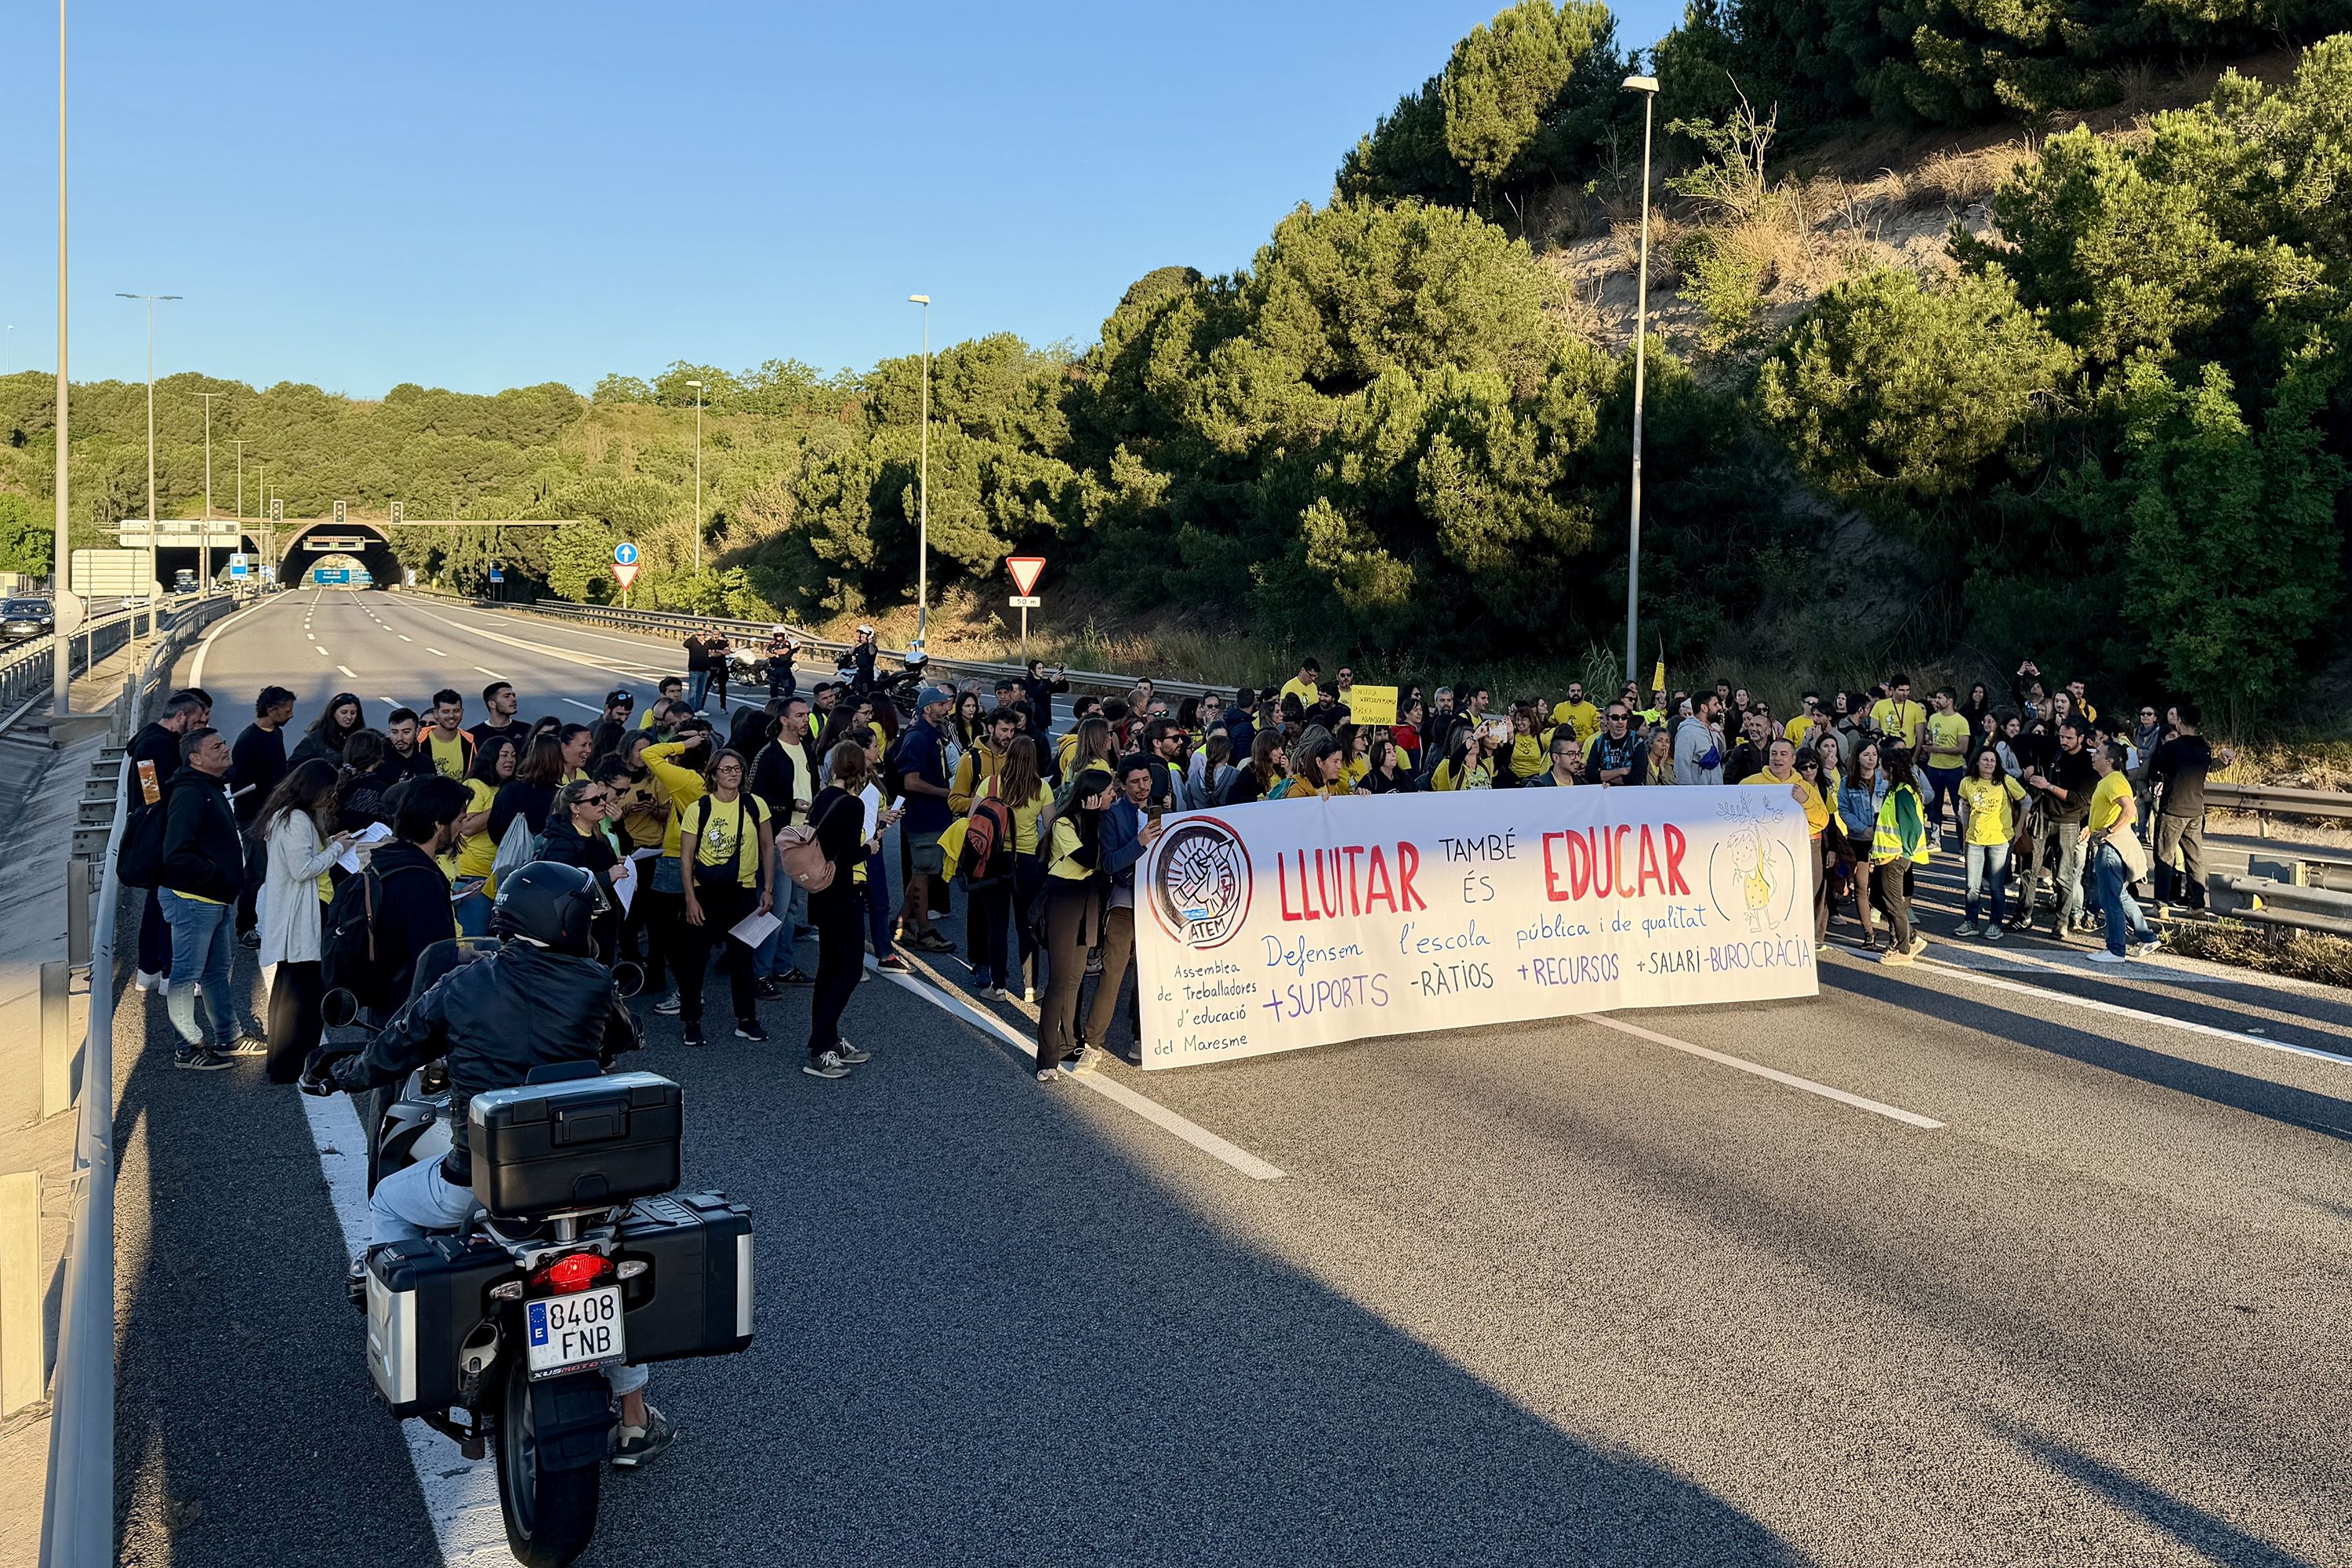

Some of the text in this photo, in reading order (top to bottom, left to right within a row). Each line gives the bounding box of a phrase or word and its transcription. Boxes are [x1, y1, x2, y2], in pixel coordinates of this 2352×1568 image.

[1439, 827, 1516, 862] TAMBÉ
[1542, 822, 1691, 902] EDUCAR
[1277, 840, 1427, 921] LLUITAR
[1464, 869, 1494, 903] ÉS
[1188, 918, 1225, 941] ATEM
[1261, 904, 1708, 977] Defensem l'escola pública i de qualitat
[1174, 959, 1240, 978] Assemblea
[1157, 985, 1173, 1001] de
[1154, 1034, 1248, 1055] del Maresme
[550, 1294, 614, 1330] 8408
[535, 1327, 543, 1338] E
[562, 1326, 611, 1359] FNB
